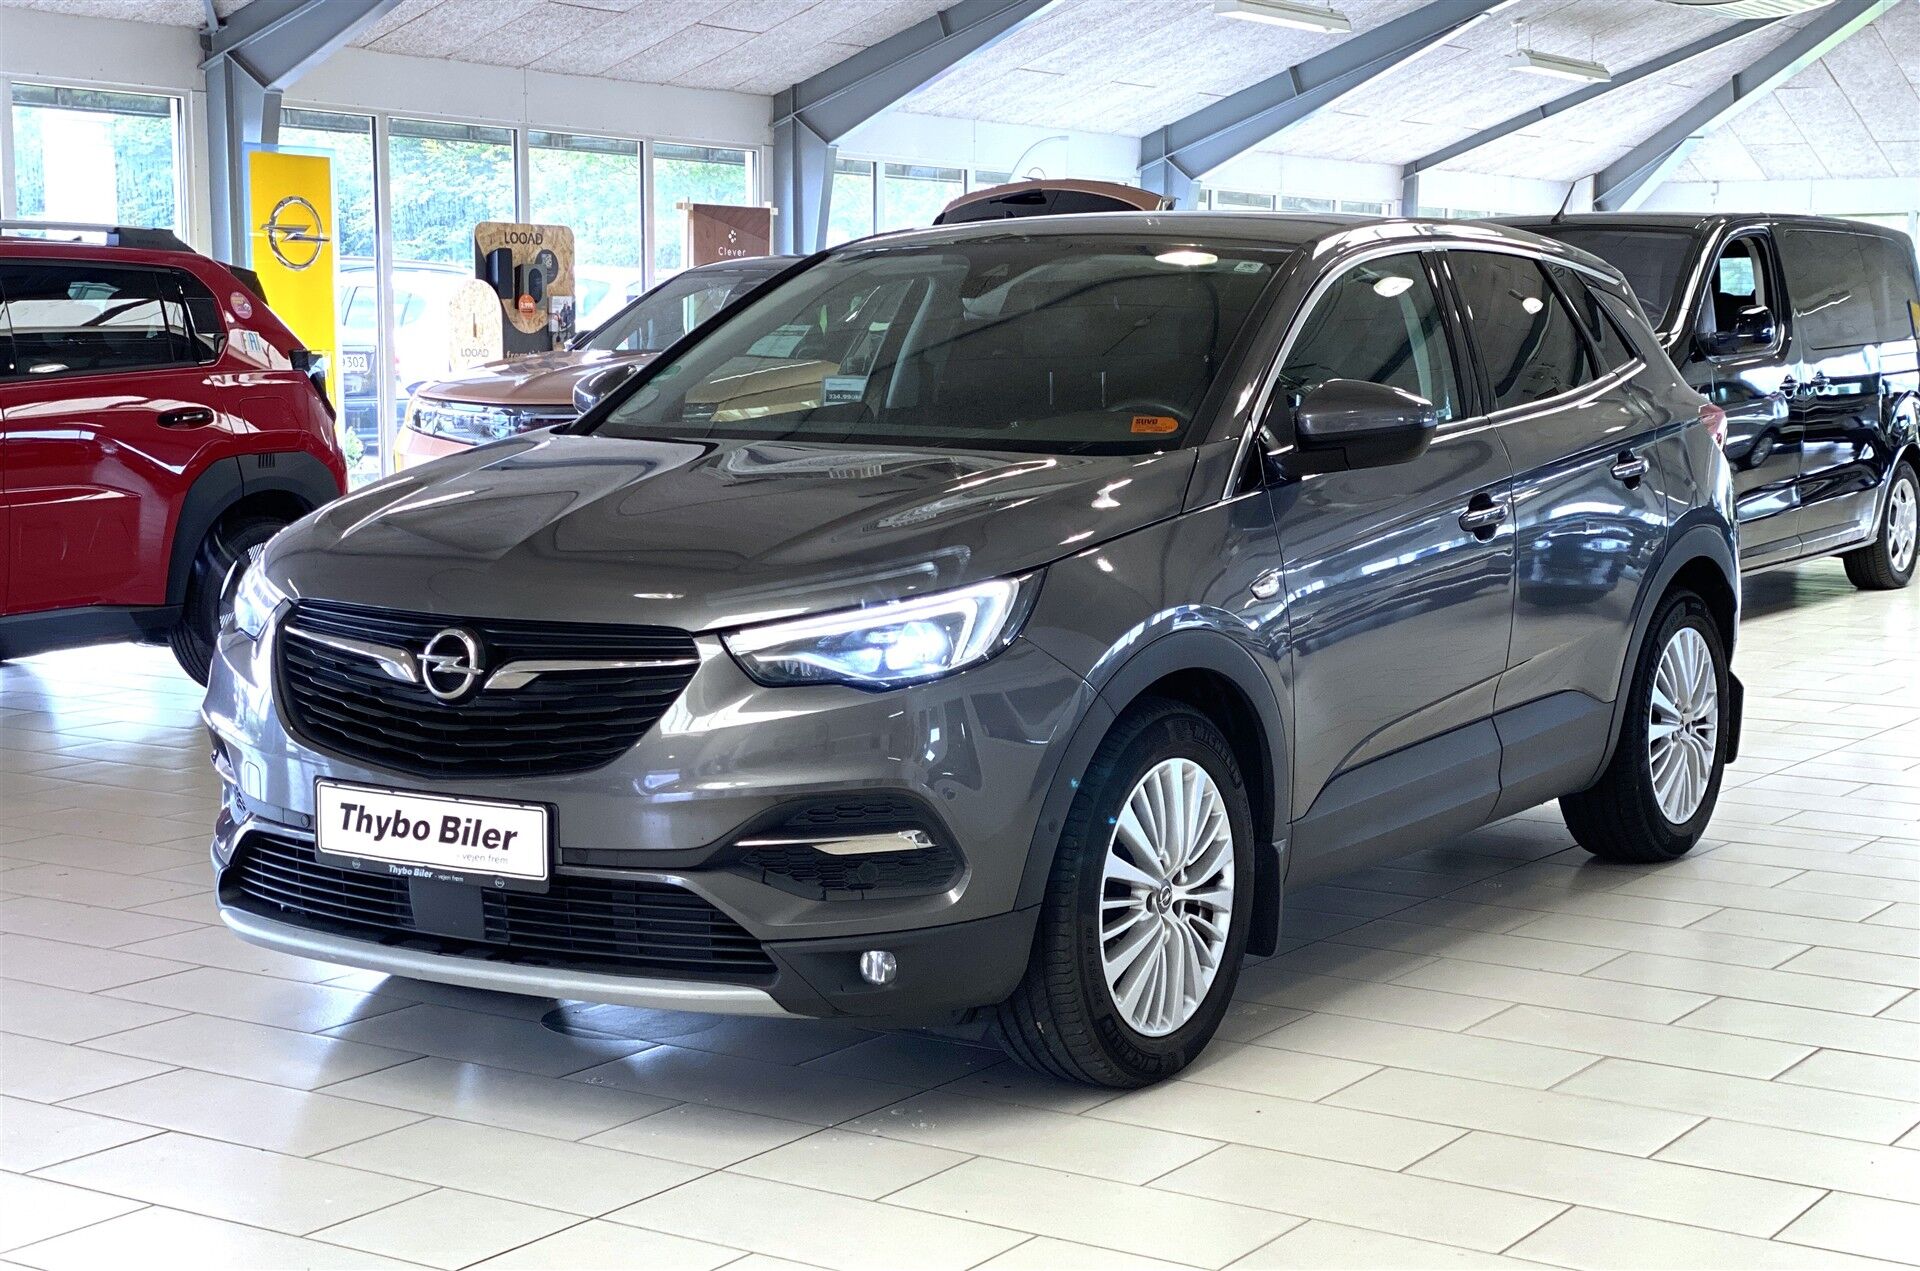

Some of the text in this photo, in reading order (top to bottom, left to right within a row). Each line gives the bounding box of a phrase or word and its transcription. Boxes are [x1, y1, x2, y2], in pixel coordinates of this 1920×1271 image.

[504, 232, 544, 245] LOOAD
[718, 246, 746, 256] Clever
[460, 348, 489, 358] LOOAD
[340, 802, 518, 851] Thybo Biler
[487, 854, 509, 864] frem
[388, 864, 413, 876] Thybo
[413, 868, 433, 878] Biler
